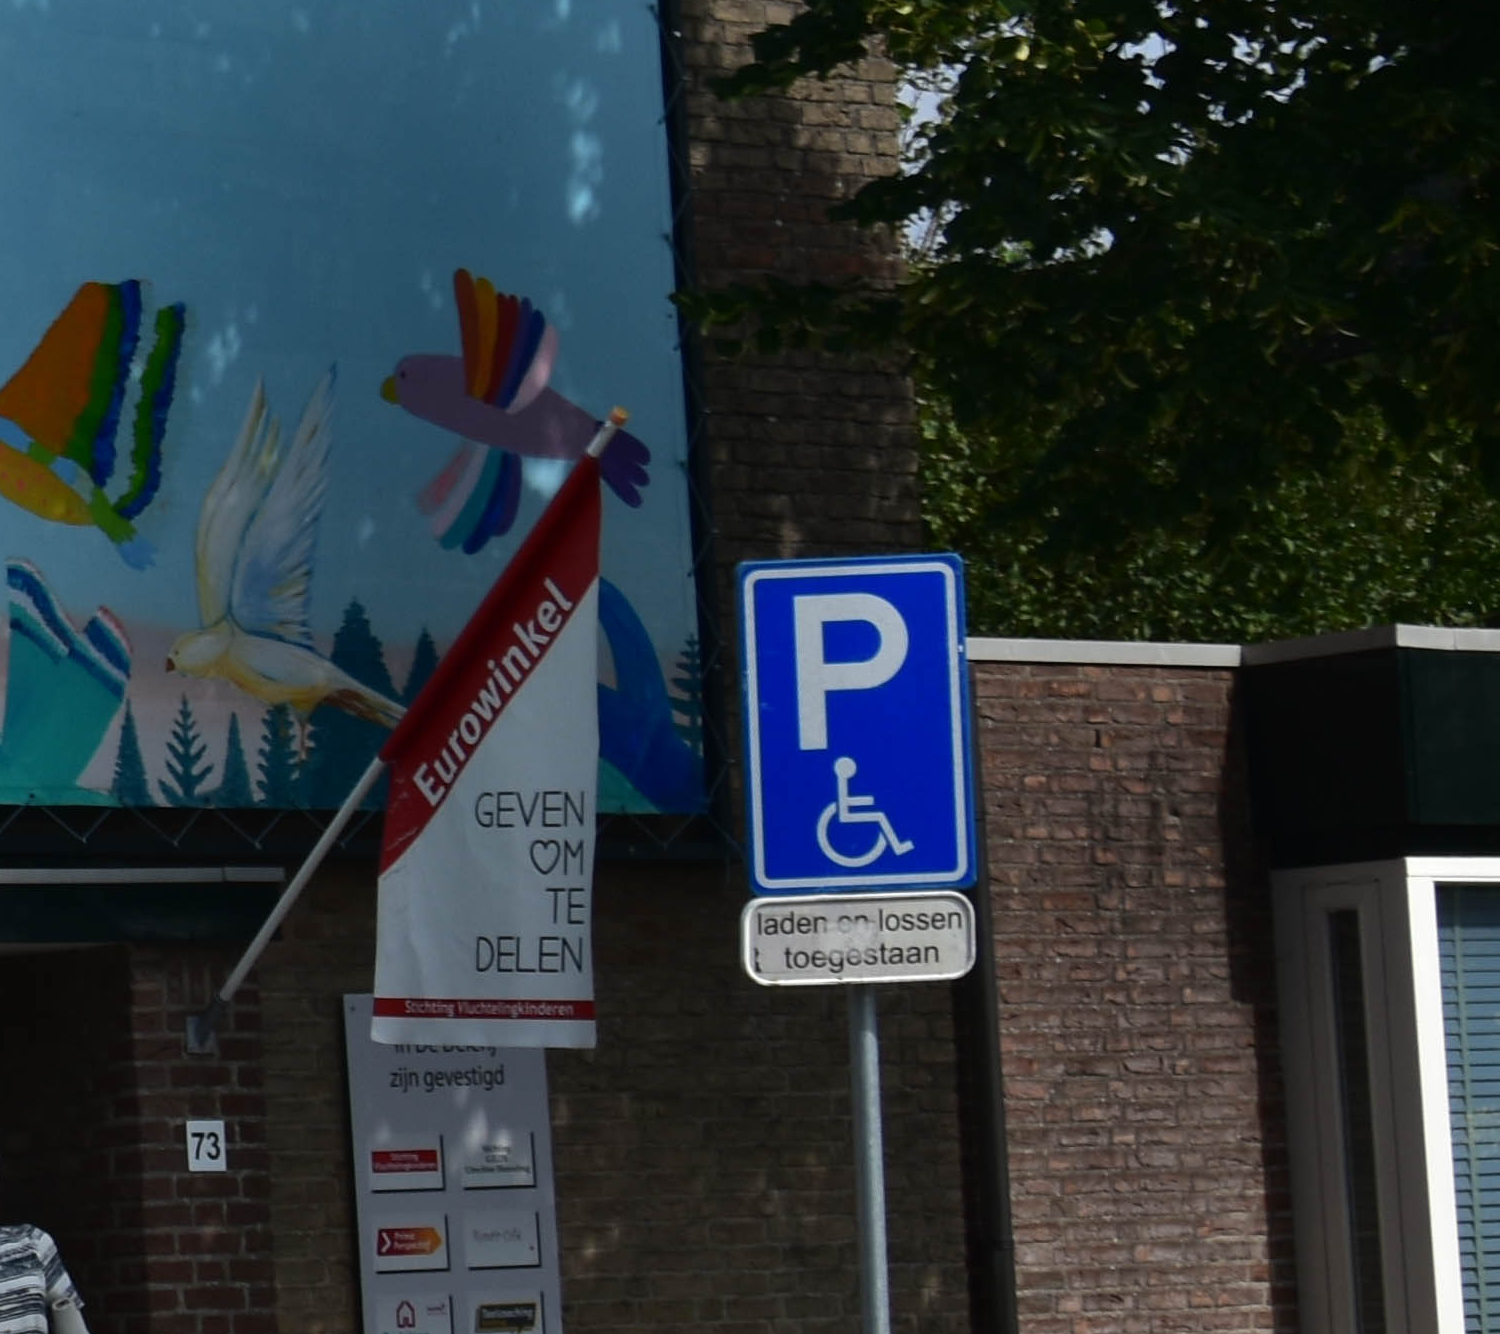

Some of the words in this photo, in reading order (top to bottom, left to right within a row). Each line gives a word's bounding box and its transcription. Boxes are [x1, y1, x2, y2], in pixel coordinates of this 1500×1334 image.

[793, 592, 909, 752] P
[413, 576, 573, 809] Eurowinkel
[474, 790, 585, 830] GEVEN
[546, 889, 585, 927] TE
[757, 911, 827, 936] laden
[878, 908, 963, 932] lossen
[475, 936, 583, 975] DELEN
[785, 943, 940, 973] toegestaan
[404, 999, 454, 1017] Stichting
[457, 1001, 574, 1020] Vluchtelingkinderen
[390, 1068, 420, 1093] zijn
[424, 1064, 504, 1093] gevestigd
[190, 1131, 221, 1161] 73
